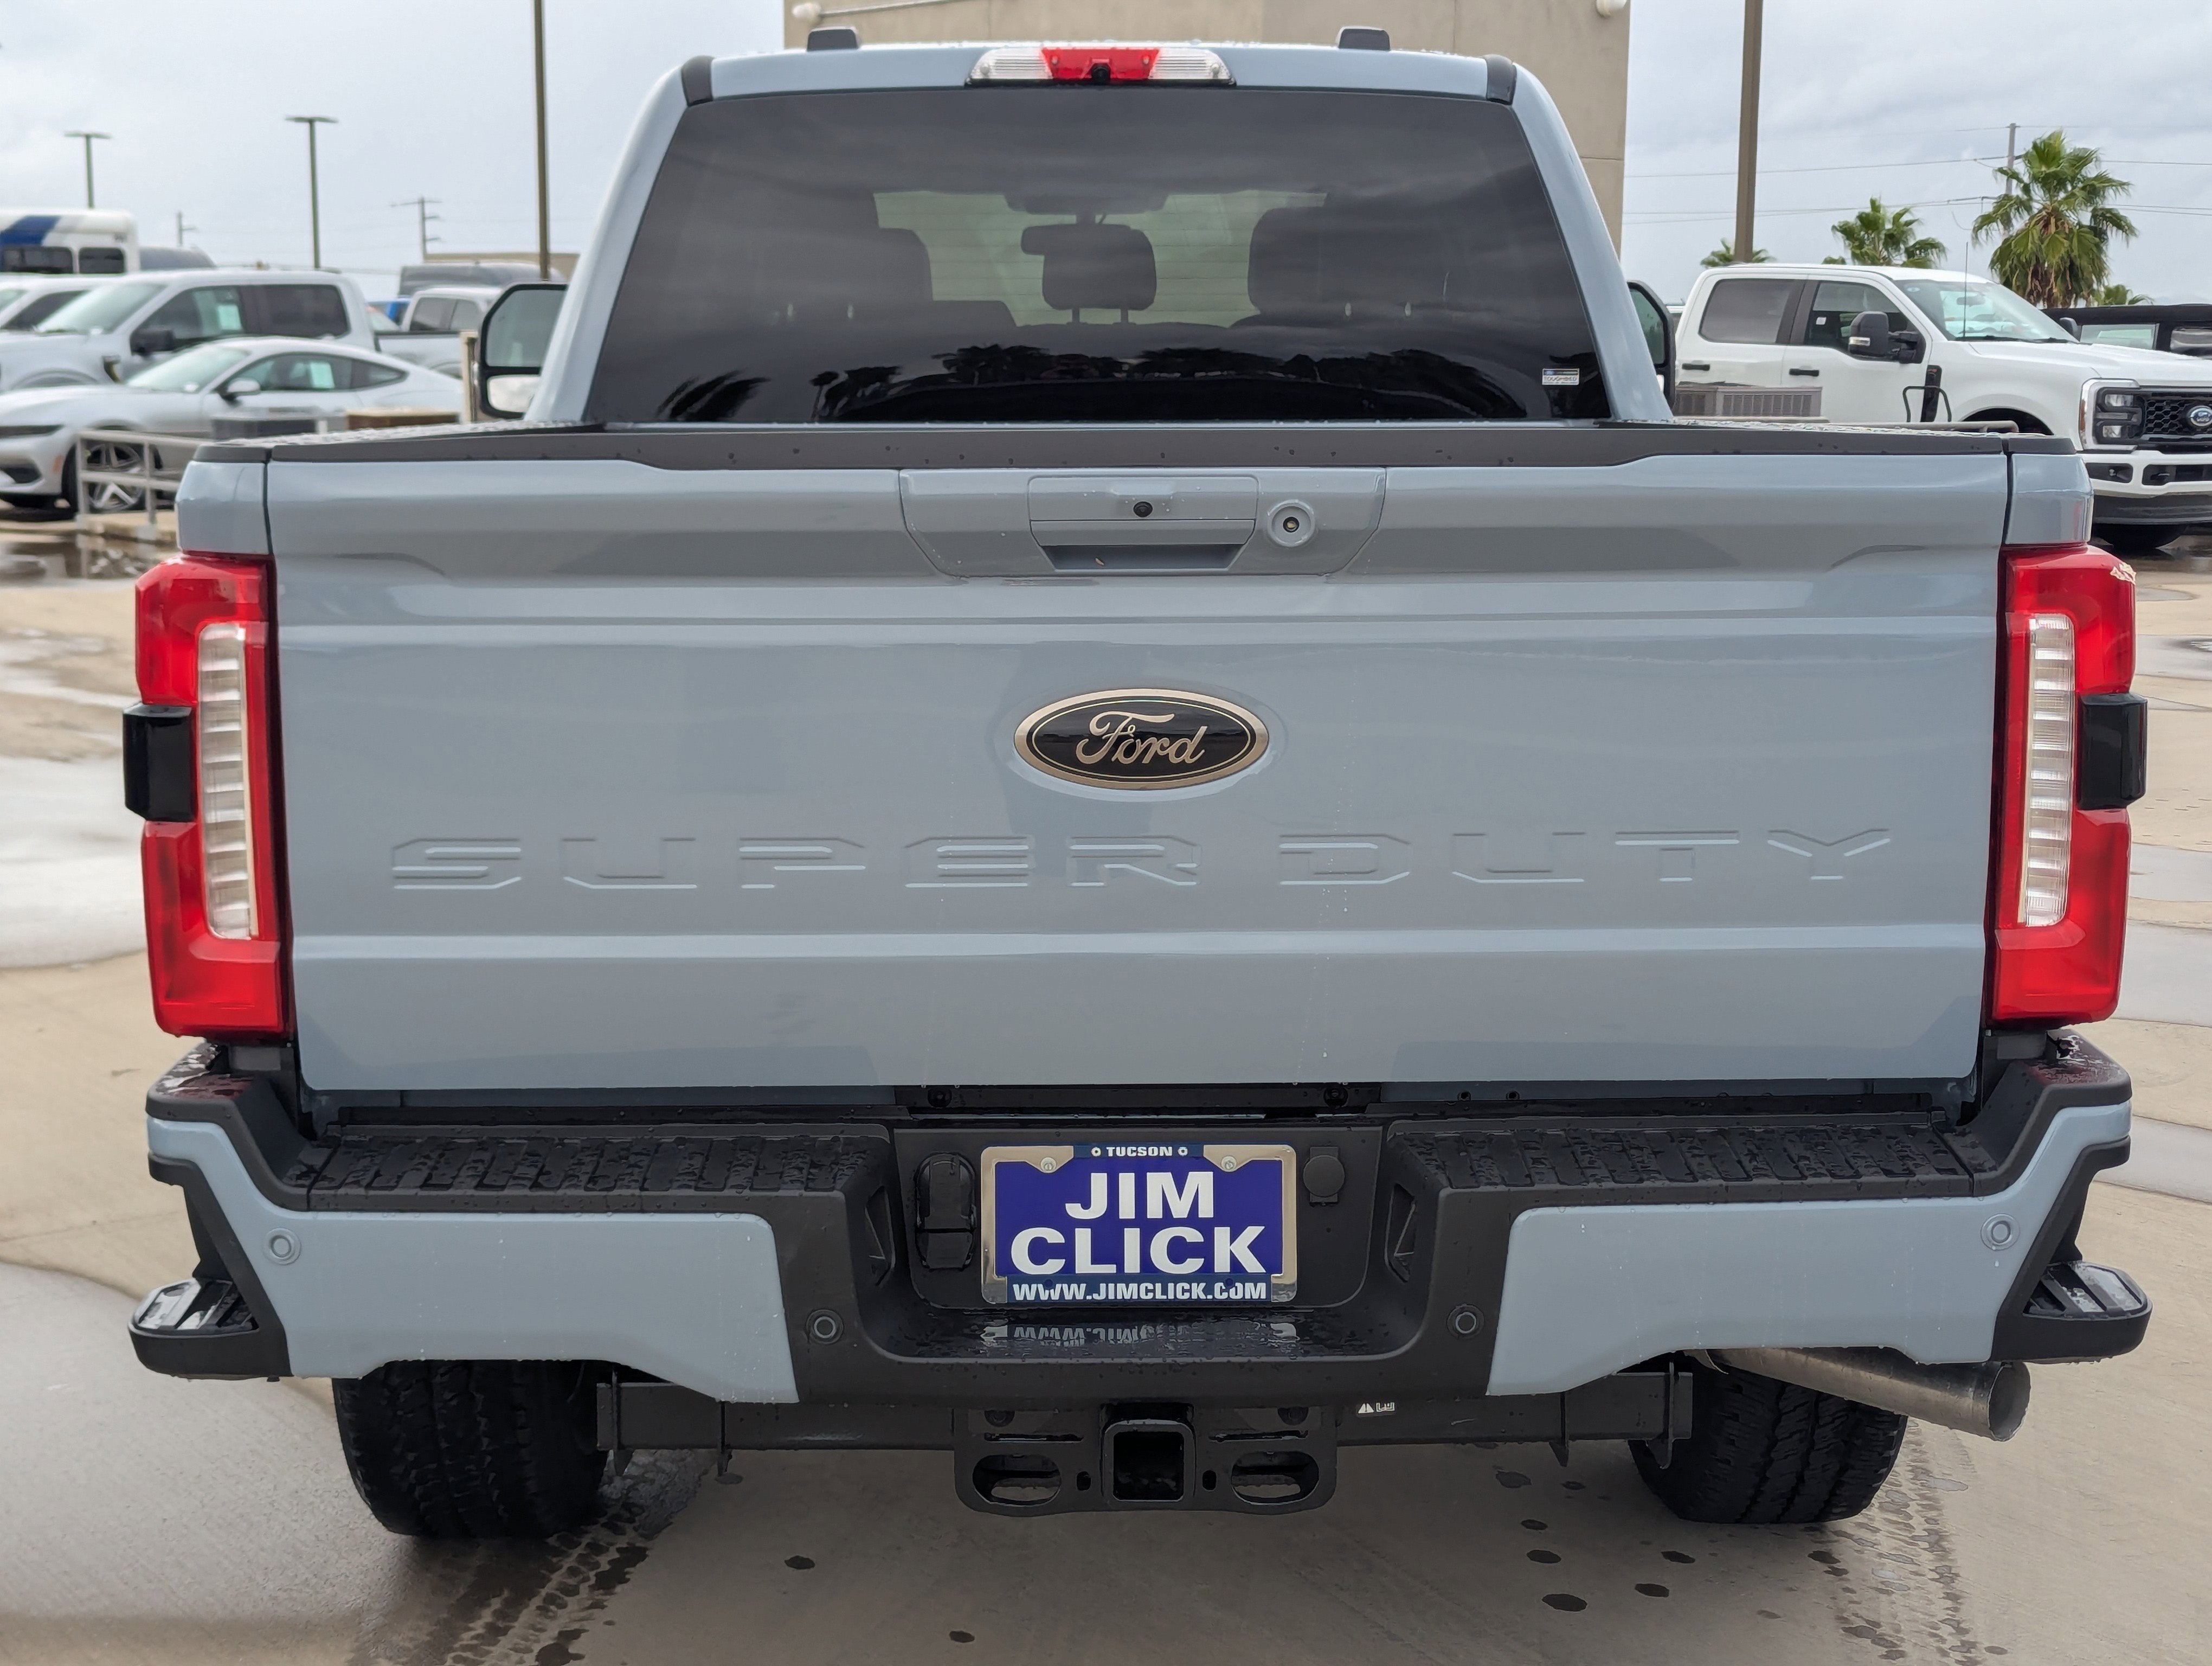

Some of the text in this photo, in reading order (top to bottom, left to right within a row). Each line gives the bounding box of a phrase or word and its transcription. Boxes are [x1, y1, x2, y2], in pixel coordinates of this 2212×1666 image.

[1075, 710, 1208, 765] Ford
[392, 828, 1891, 889] SUPER DUTY
[1106, 1146, 1173, 1157] TUCSON
[1065, 1171, 1214, 1219] JIM
[1011, 1226, 1266, 1275] CLICK
[1012, 1281, 1266, 1301] WWW.JIMCLICK.COM
